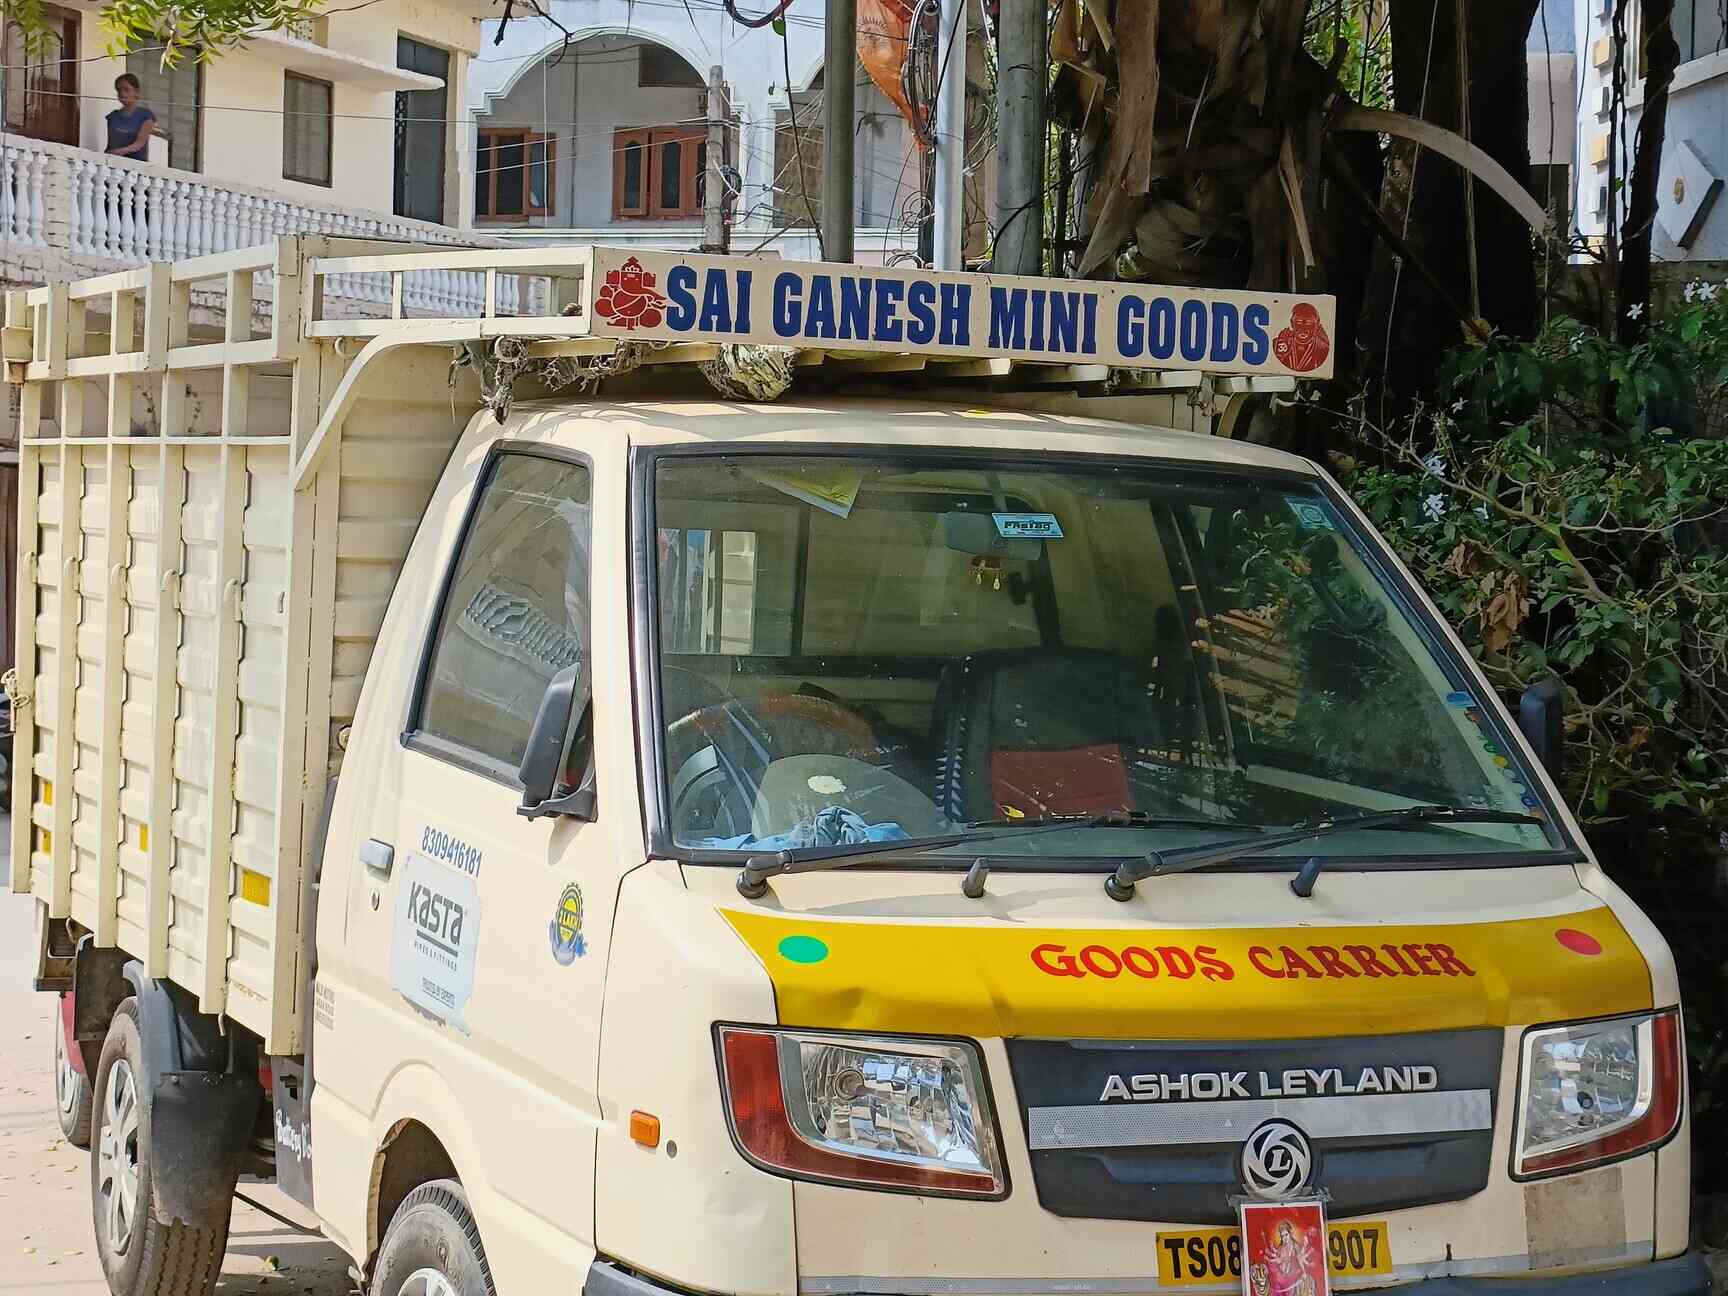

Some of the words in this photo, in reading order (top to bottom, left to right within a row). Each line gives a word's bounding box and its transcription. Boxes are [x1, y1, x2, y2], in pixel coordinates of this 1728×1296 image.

[667, 265, 751, 332] SAI
[773, 272, 970, 346] GANESH
[988, 285, 1098, 355] MINI
[1117, 295, 1271, 366] GOODS
[421, 826, 482, 877] 8309416181
[1030, 943, 1234, 981] GOODS
[1247, 942, 1477, 980] CARRIER
[1099, 1071, 1251, 1101] ASHOK
[1258, 1065, 1438, 1097] LEYLAND
[1164, 1234, 1242, 1280] TS08
